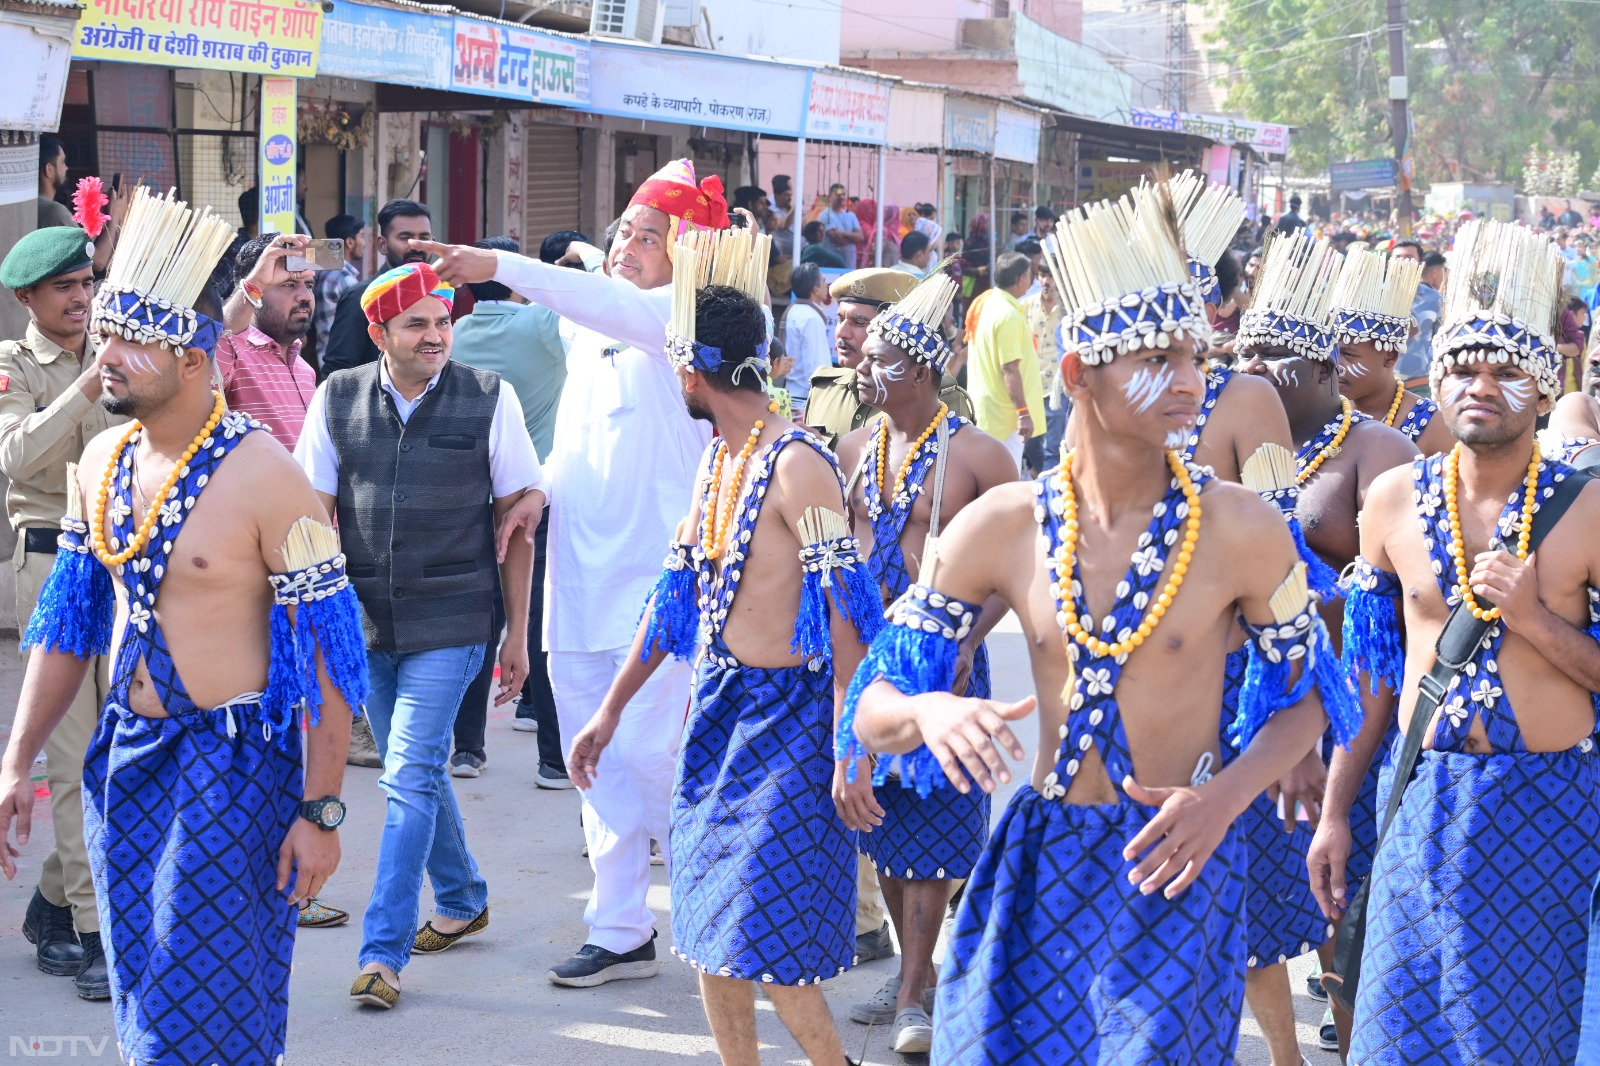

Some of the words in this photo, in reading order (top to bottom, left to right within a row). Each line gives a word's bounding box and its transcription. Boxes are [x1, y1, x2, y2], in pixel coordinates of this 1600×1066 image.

[282, 0, 319, 39] शॉप
[80, 22, 146, 51] अंग्रेजी
[148, 34, 162, 53] व
[165, 30, 200, 56] देशी
[202, 41, 245, 61] शराब
[248, 41, 269, 63] की
[270, 47, 313, 70] दुकान
[455, 26, 499, 86] अम्बे
[498, 28, 531, 88] टेन्ट
[531, 49, 576, 96] हाऊस
[651, 93, 661, 109] के
[708, 100, 744, 120] पोकरण
[265, 175, 293, 214] अंग्रेजी
